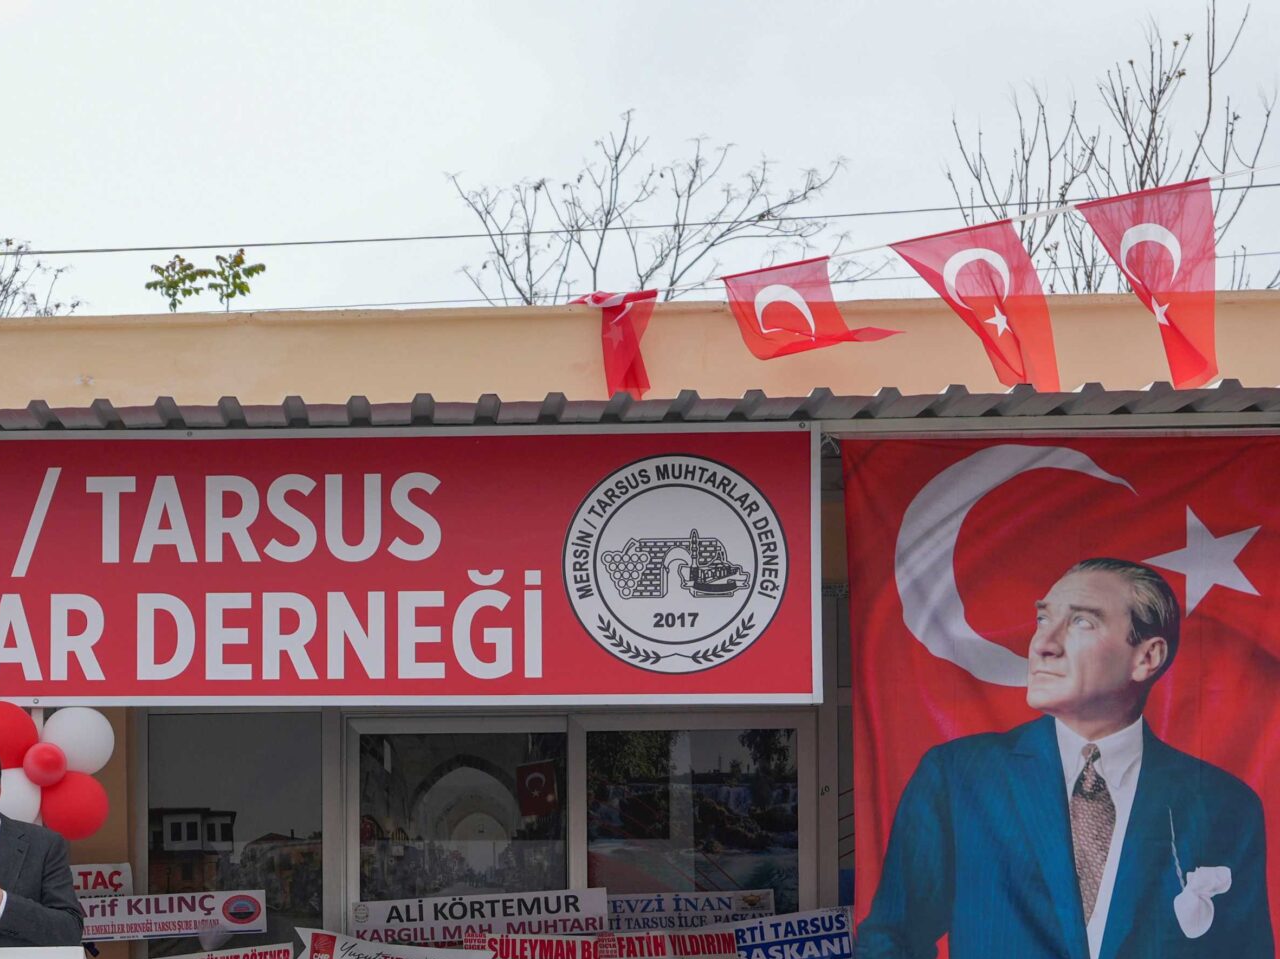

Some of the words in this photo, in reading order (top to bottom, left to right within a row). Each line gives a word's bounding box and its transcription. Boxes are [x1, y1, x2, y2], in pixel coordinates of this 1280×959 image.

[11, 467, 61, 576] /
[86, 472, 441, 563] TARSUS
[572, 530, 594, 600] MERSİN
[588, 468, 651, 519] TARSUS
[655, 464, 760, 518] MUHTARLAR
[752, 516, 779, 600] DERNEĞİ
[137, 569, 542, 680] DERNEĞİ
[653, 612, 699, 628] 2017
[127, 895, 216, 916] KILINÇ
[386, 900, 424, 923] ALİ
[434, 894, 581, 921] KÖRTEMUR
[609, 894, 665, 914] EVZİ
[673, 894, 732, 912] İNAN
[154, 920, 176, 932] TARSUS
[356, 928, 435, 943] KARGILI
[507, 916, 603, 934] MUHTARI
[625, 916, 675, 930] TARSUS
[770, 914, 845, 939] TARSUS
[617, 932, 666, 958] FATİH
[669, 933, 736, 956] YILDIRIM
